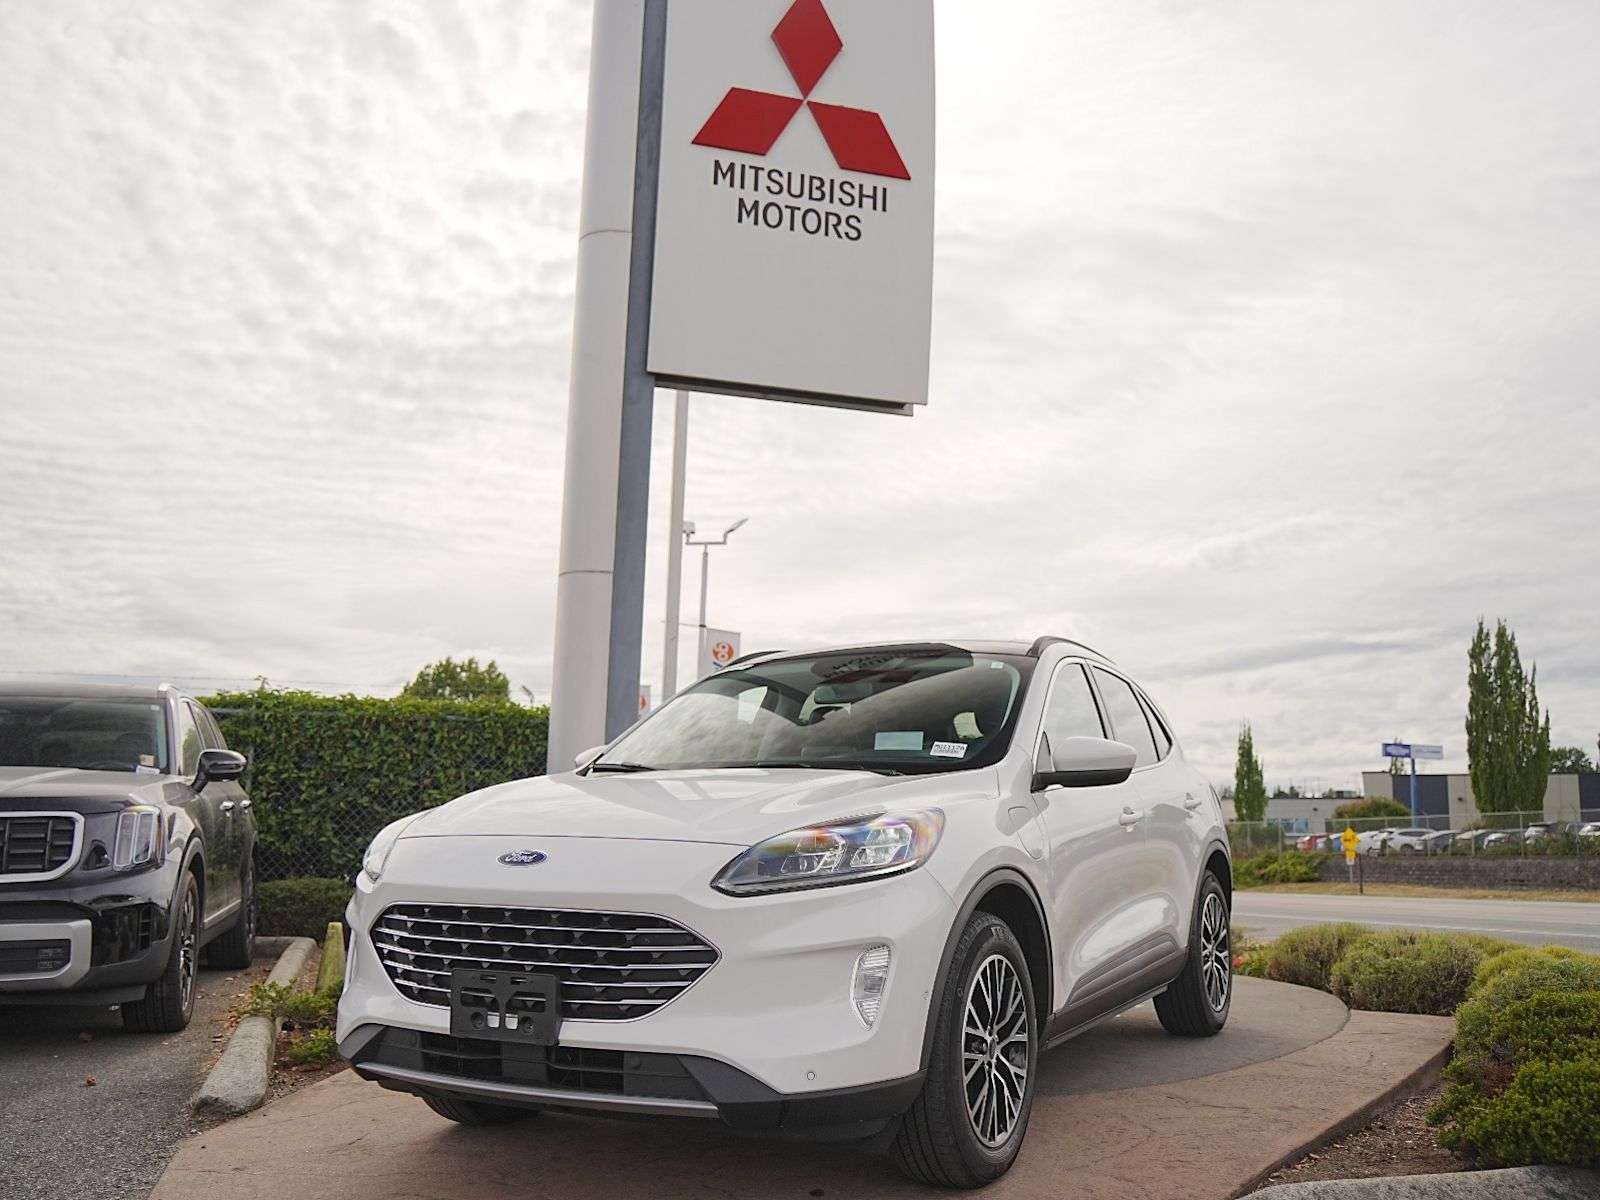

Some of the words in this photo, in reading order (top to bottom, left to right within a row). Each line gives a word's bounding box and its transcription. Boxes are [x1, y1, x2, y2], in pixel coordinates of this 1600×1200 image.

[713, 159, 888, 212] MITSUBISHI
[737, 197, 862, 241] MOTORS
[504, 851, 538, 863] Ford
